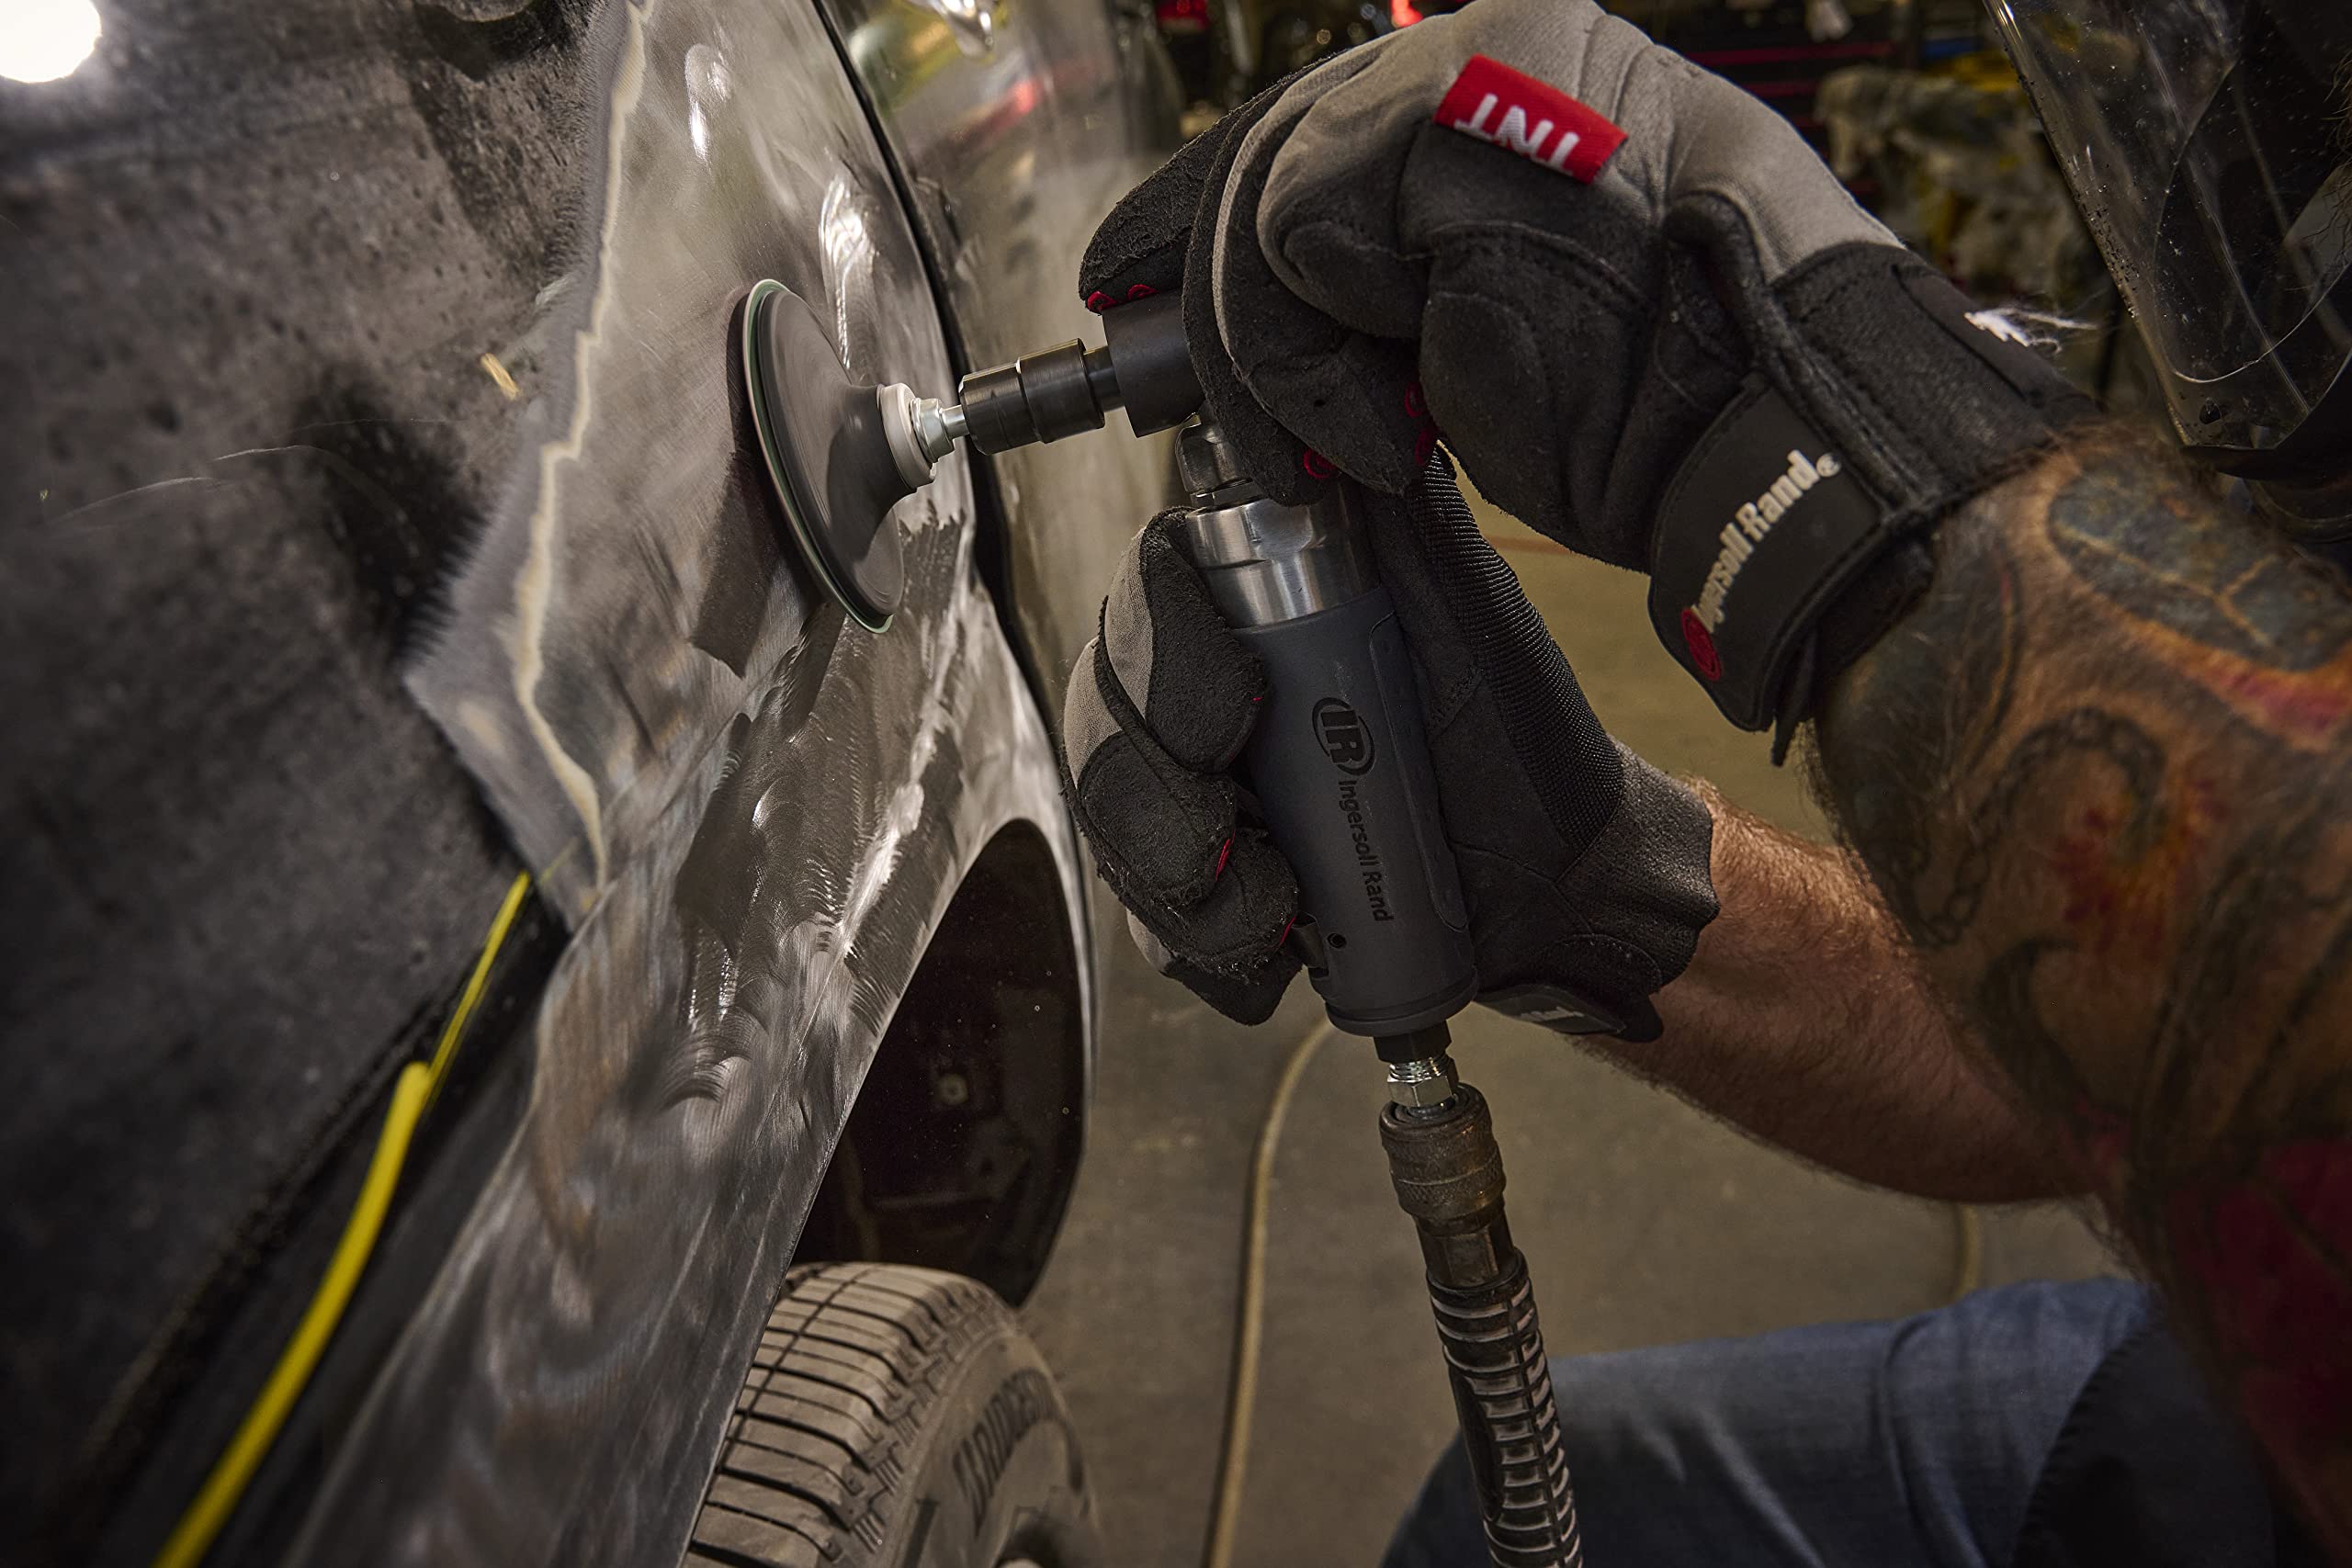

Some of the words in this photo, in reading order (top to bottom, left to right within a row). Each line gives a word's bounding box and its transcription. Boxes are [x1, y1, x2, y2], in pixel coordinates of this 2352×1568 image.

[1453, 93, 1580, 176] TNT
[1318, 708, 1366, 765] IR
[1338, 780, 1380, 866] Ingersoll
[1362, 870, 1395, 922] Rand
